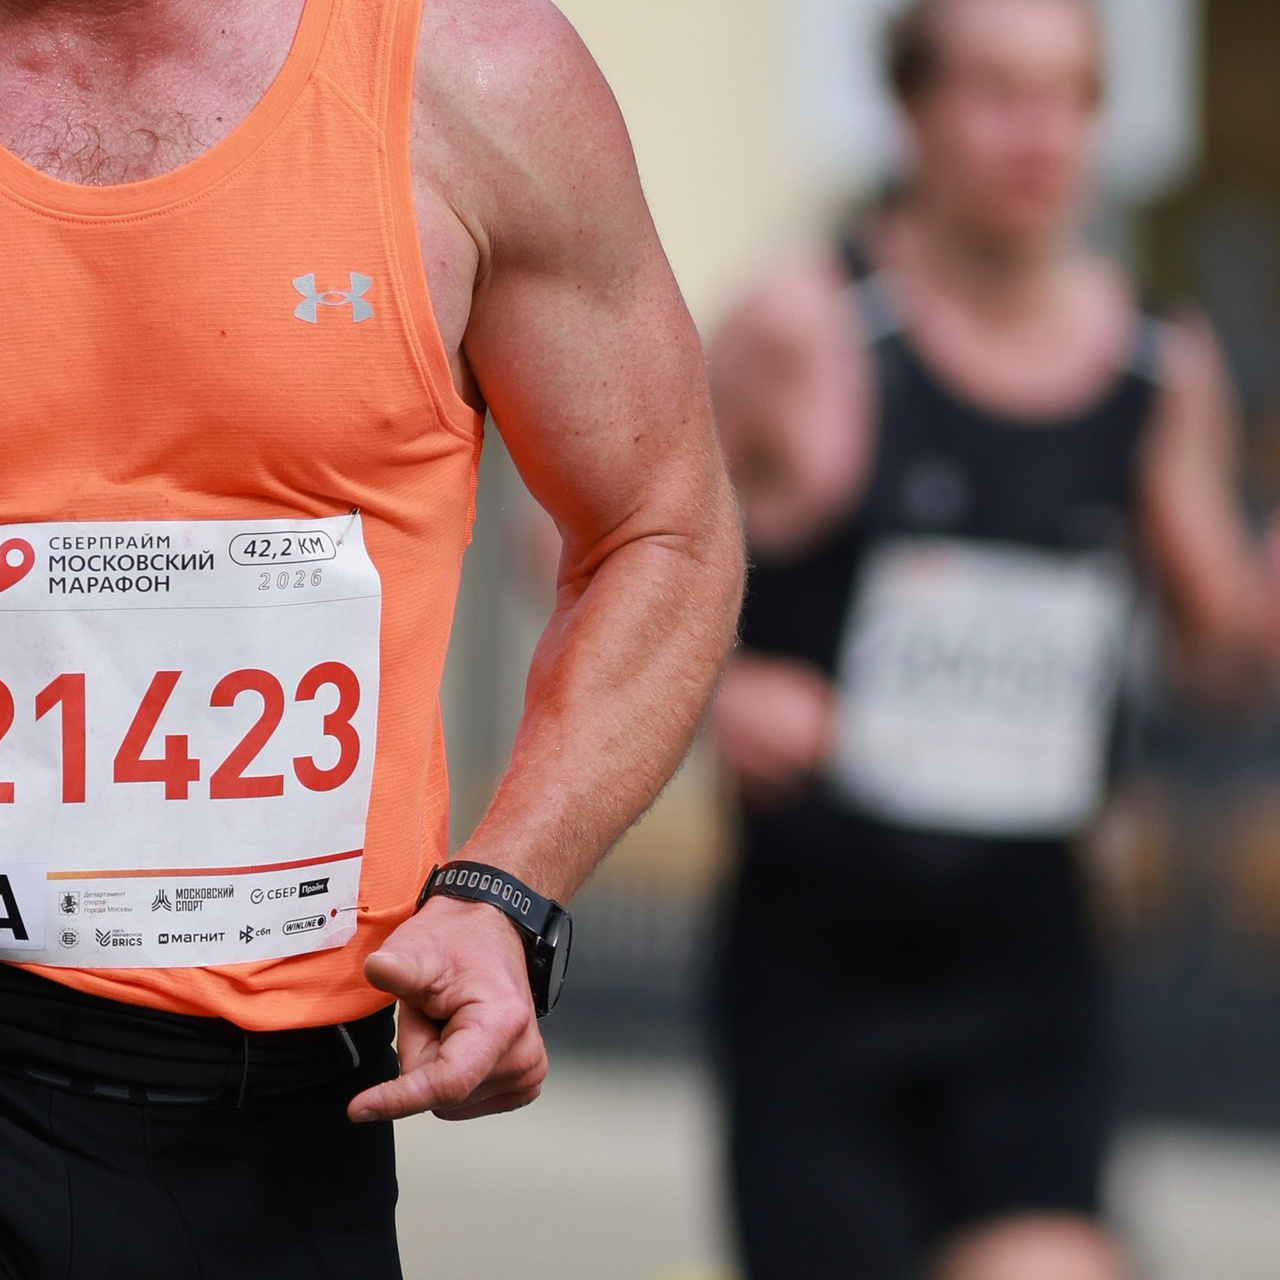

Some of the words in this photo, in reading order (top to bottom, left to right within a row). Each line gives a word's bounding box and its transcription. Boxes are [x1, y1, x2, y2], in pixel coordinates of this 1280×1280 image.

[49, 533, 170, 550] СБЕРПРАЙМ
[243, 538, 292, 560] 42,2
[298, 537, 325, 555] КМ
[49, 550, 214, 572] МОСКОВСКИЙ
[49, 575, 170, 594] МАРАФОН
[257, 568, 322, 591] 2026
[176, 884, 234, 899] МОСКОВСКИЙ
[267, 886, 297, 900] СБЕР
[176, 900, 204, 912] СПОРТ
[255, 927, 271, 937] сбп
[286, 918, 317, 933] WINLINE
[112, 937, 143, 947] BRICS
